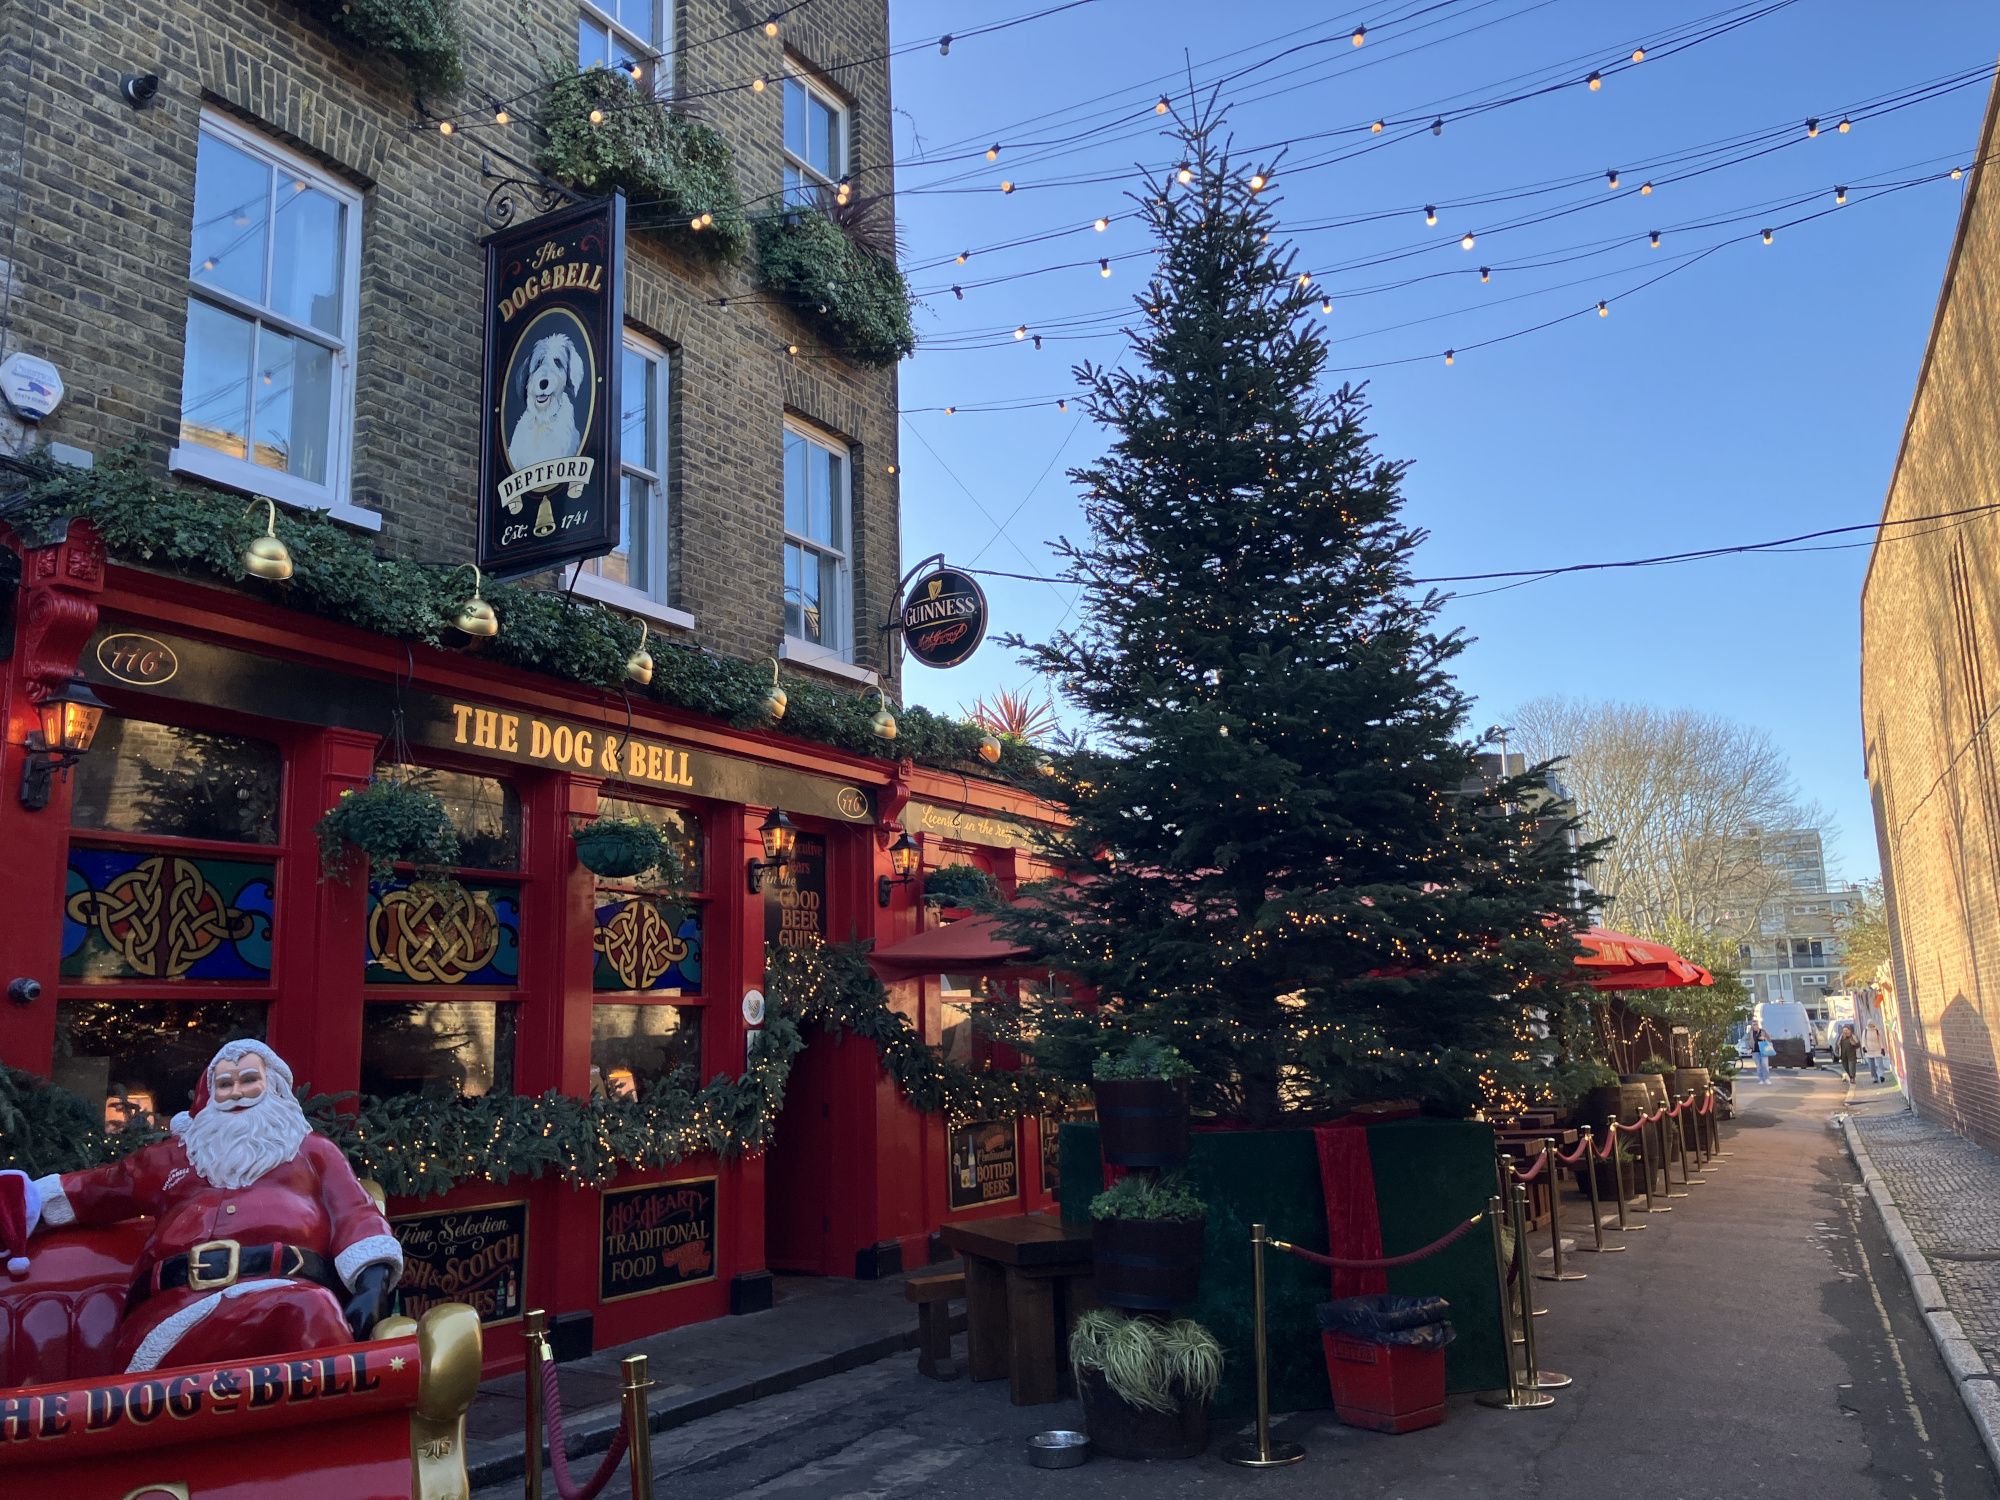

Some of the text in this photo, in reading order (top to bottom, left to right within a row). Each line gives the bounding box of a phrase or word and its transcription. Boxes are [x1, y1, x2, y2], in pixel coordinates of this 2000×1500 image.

[531, 240, 566, 270] The
[503, 460, 588, 498] DEPTFORD
[501, 510, 588, 546] Est. 1741
[905, 597, 976, 627] GUINNESS
[111, 645, 166, 676] 116
[453, 703, 693, 787] THE DOG & BELL
[921, 804, 963, 829] Licensed
[964, 820, 976, 832] in
[977, 819, 994, 836] the
[766, 871, 797, 887] in the
[779, 888, 821, 911] GOOD
[781, 908, 820, 931] BEER
[977, 1162, 1014, 1182] BOTTLED
[983, 1180, 1010, 1198] BEERS
[640, 1190, 710, 1229] HEARTY
[438, 1215, 508, 1247] Selection
[606, 1220, 710, 1256] TRADITIONAL
[441, 1234, 519, 1294] SCOTCH
[444, 1245, 457, 1255] OF
[612, 1255, 657, 1282] FOOD
[85, 1376, 204, 1434] DOG
[246, 1351, 381, 1411] BELL
